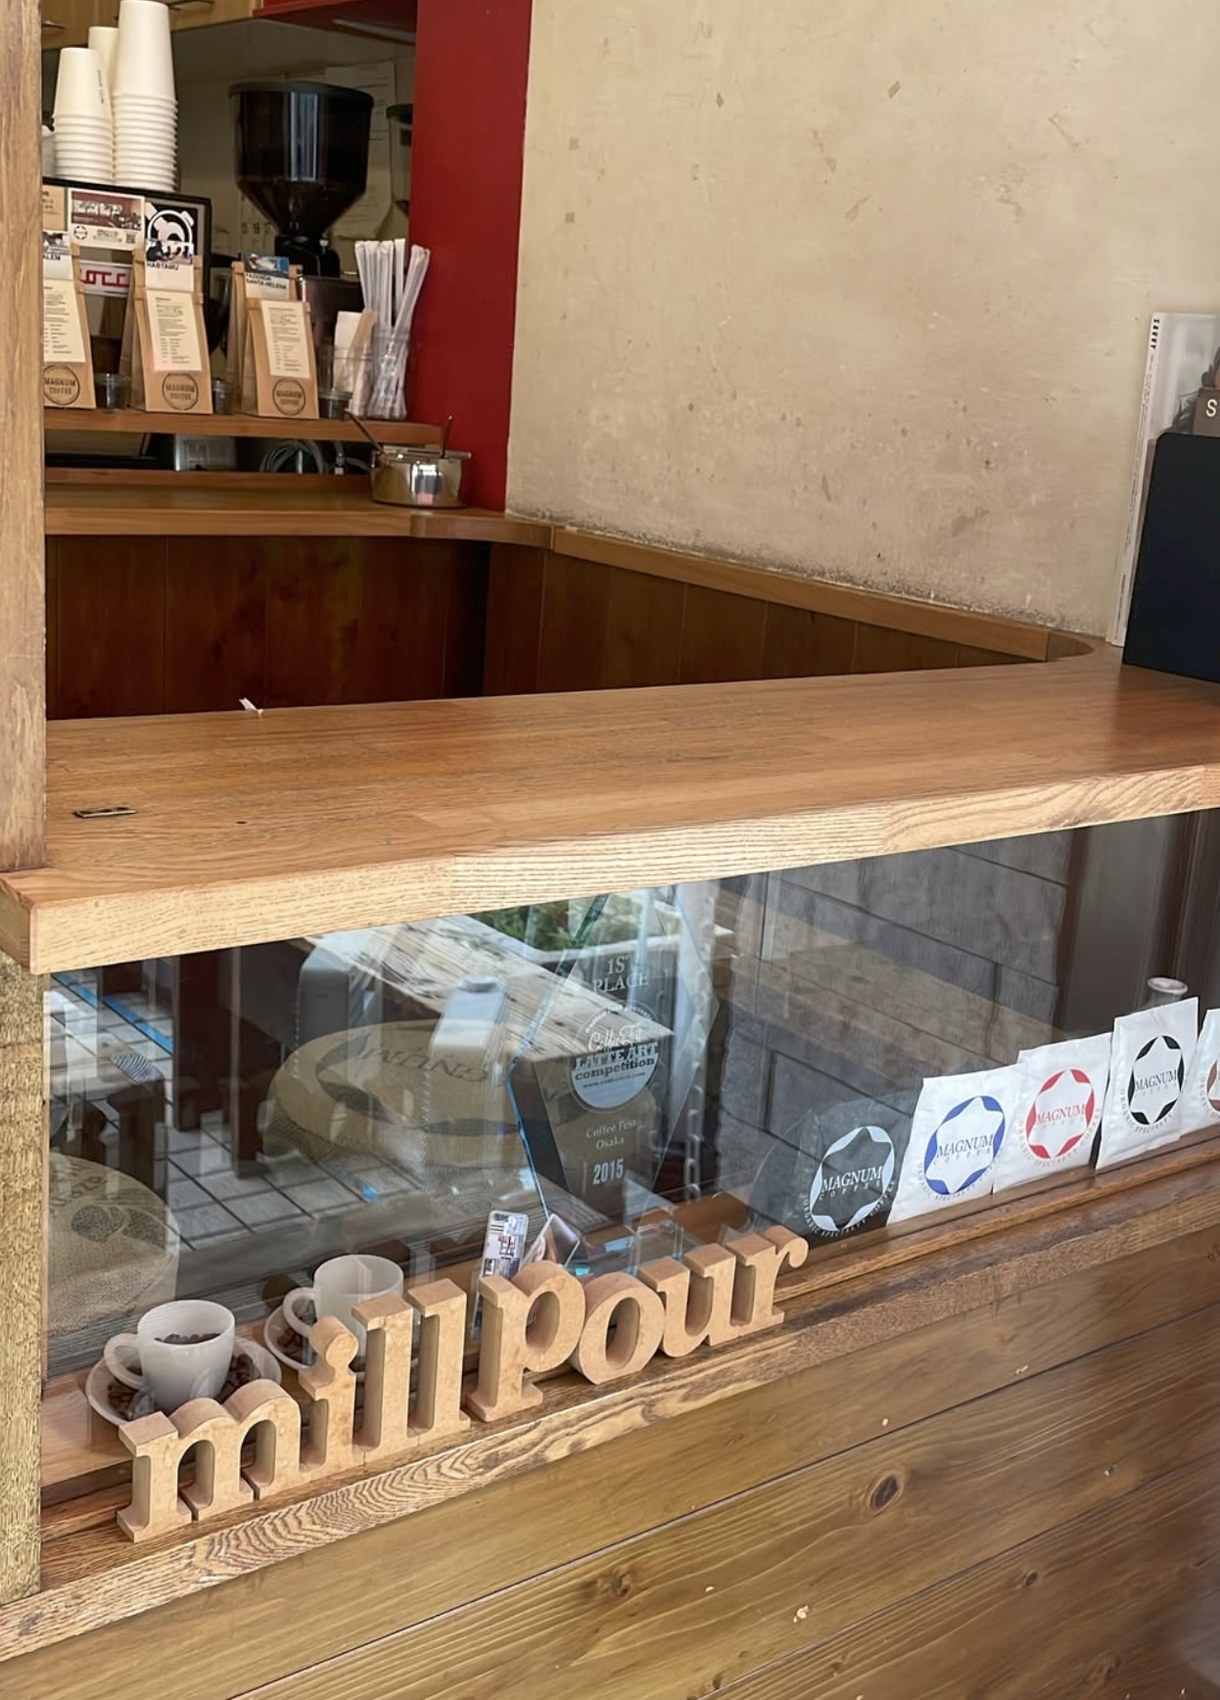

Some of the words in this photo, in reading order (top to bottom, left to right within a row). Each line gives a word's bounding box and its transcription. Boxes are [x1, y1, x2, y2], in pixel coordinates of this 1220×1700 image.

[593, 972, 650, 994] PLACE
[626, 1042, 659, 1062] ART
[575, 1056, 656, 1082] competition
[1135, 1069, 1178, 1092] MAGNUM
[1037, 1103, 1085, 1124] MAGNUM
[586, 1120, 617, 1140] Coffee
[596, 1135, 625, 1151] Osaka
[936, 1133, 994, 1159] MAGNUM
[593, 1157, 625, 1186] 2015
[822, 1166, 884, 1192] MAGNUM
[819, 1180, 882, 1201] COFFEE
[803, 1197, 820, 1234] ORGANIC
